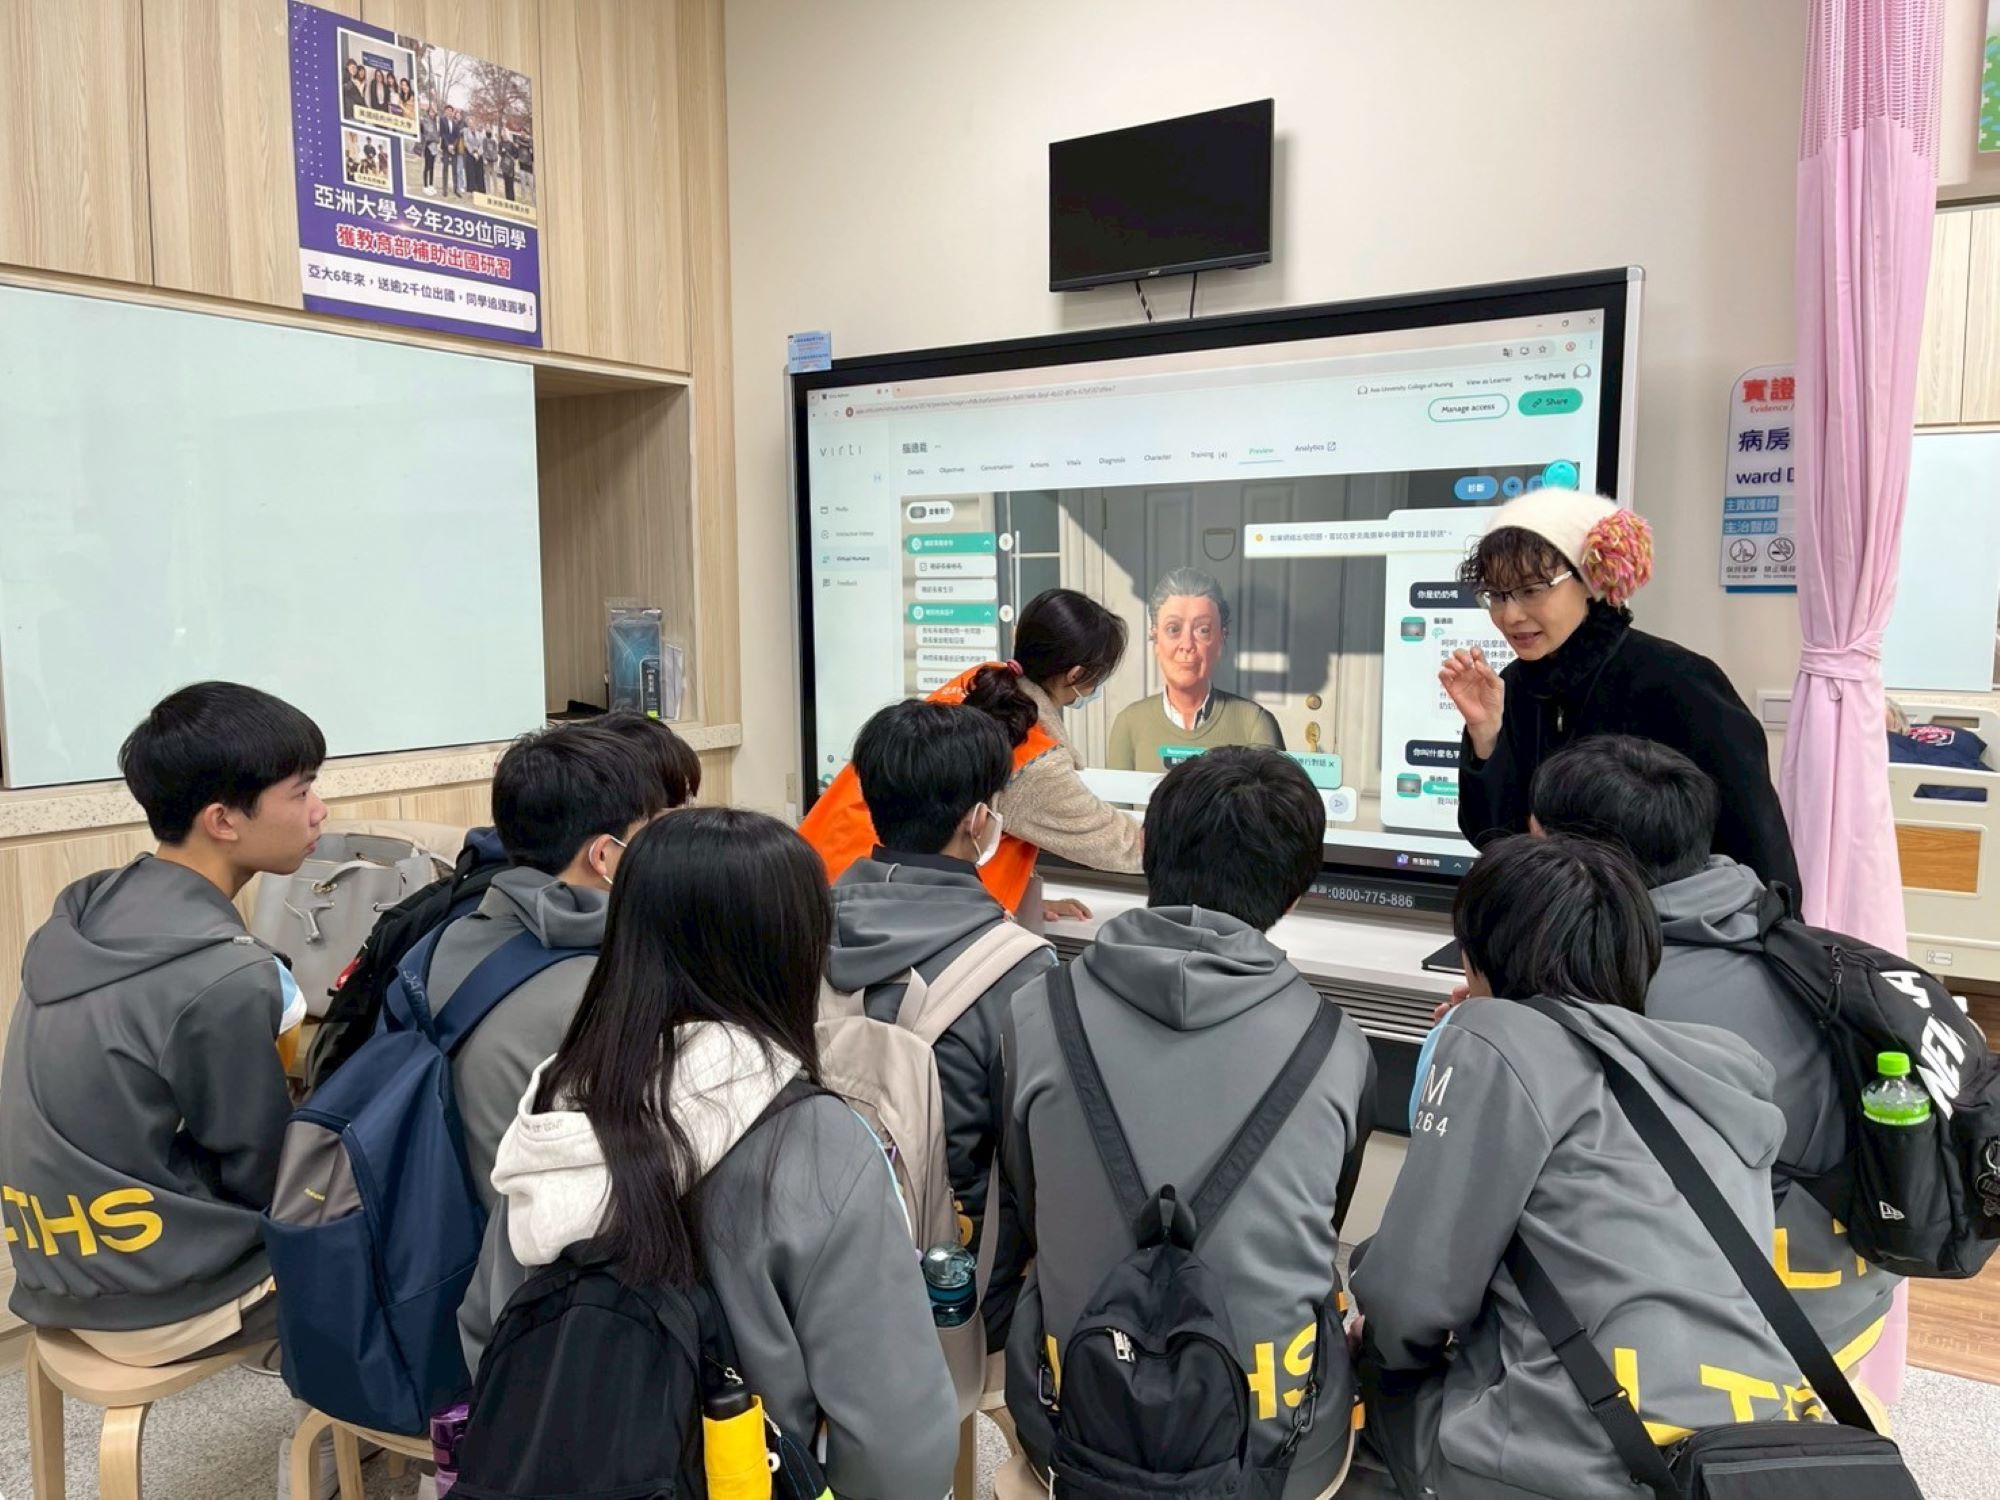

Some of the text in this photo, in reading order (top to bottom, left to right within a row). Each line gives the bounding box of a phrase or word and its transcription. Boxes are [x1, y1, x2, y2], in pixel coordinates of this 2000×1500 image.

[314, 184, 398, 222] 亞洲大學
[404, 205, 527, 251] 今年239位同學
[336, 223, 512, 281] 獲教育部補助出國研習
[1545, 396, 1569, 407] Share
[1441, 403, 1496, 415] Manage access
[1750, 404, 1788, 414] Evidence
[1738, 427, 1790, 452] 病房
[1190, 449, 1215, 459] Training
[1248, 447, 1274, 455] Preview
[1294, 443, 1325, 453] Analytics
[1736, 467, 1782, 484] ward
[1421, 1064, 1453, 1106] M
[1415, 1110, 1449, 1137] 264
